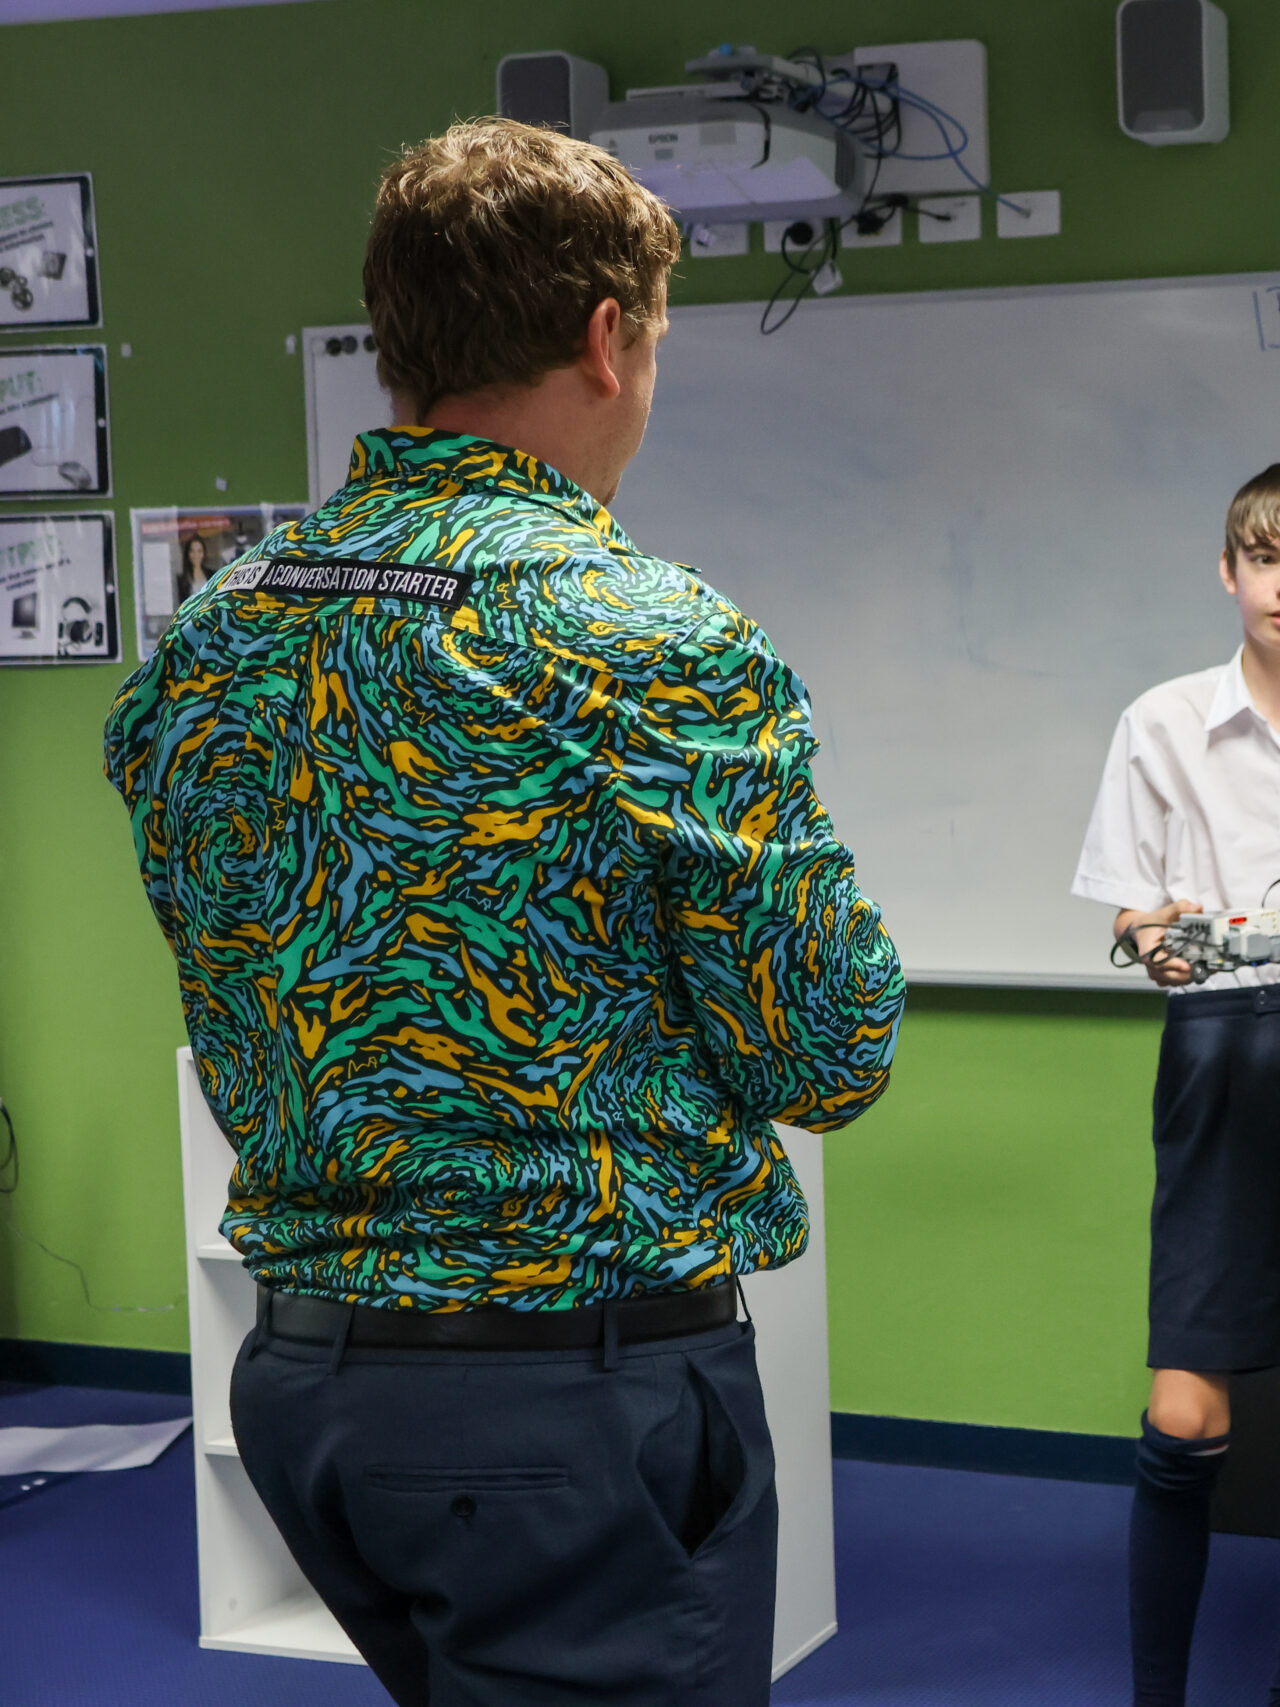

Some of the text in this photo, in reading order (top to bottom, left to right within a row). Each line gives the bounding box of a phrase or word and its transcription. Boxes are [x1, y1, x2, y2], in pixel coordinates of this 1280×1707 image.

[261, 565, 276, 586] A
[271, 564, 376, 592] CONVERSATION
[378, 569, 458, 601] STARTER
